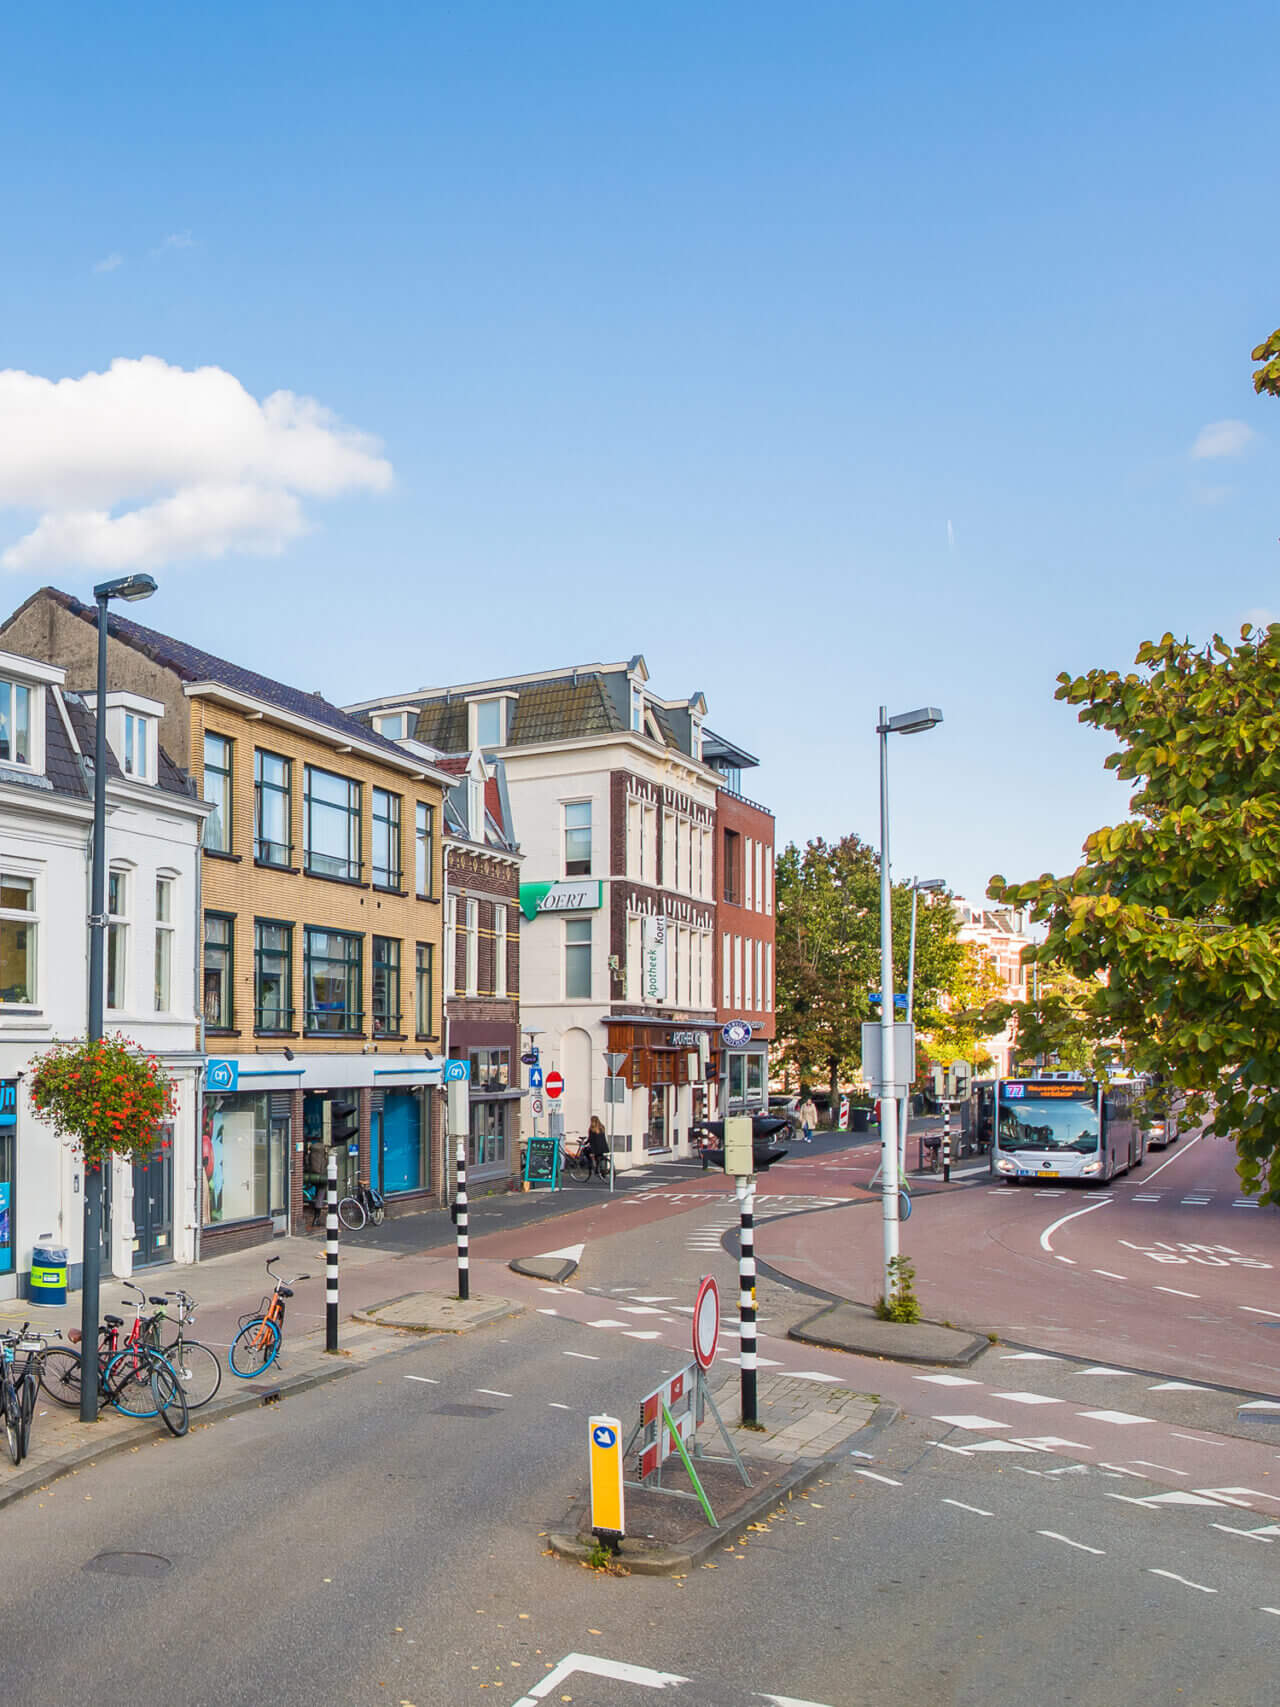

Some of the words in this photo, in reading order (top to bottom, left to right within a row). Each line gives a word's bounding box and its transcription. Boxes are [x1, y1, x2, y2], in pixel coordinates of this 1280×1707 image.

[534, 893, 588, 910] KOERT
[654, 917, 665, 944] Koert
[647, 949, 657, 997] Apotheek
[1006, 1086, 1023, 1096] 77
[1144, 1252, 1274, 1269] BUS
